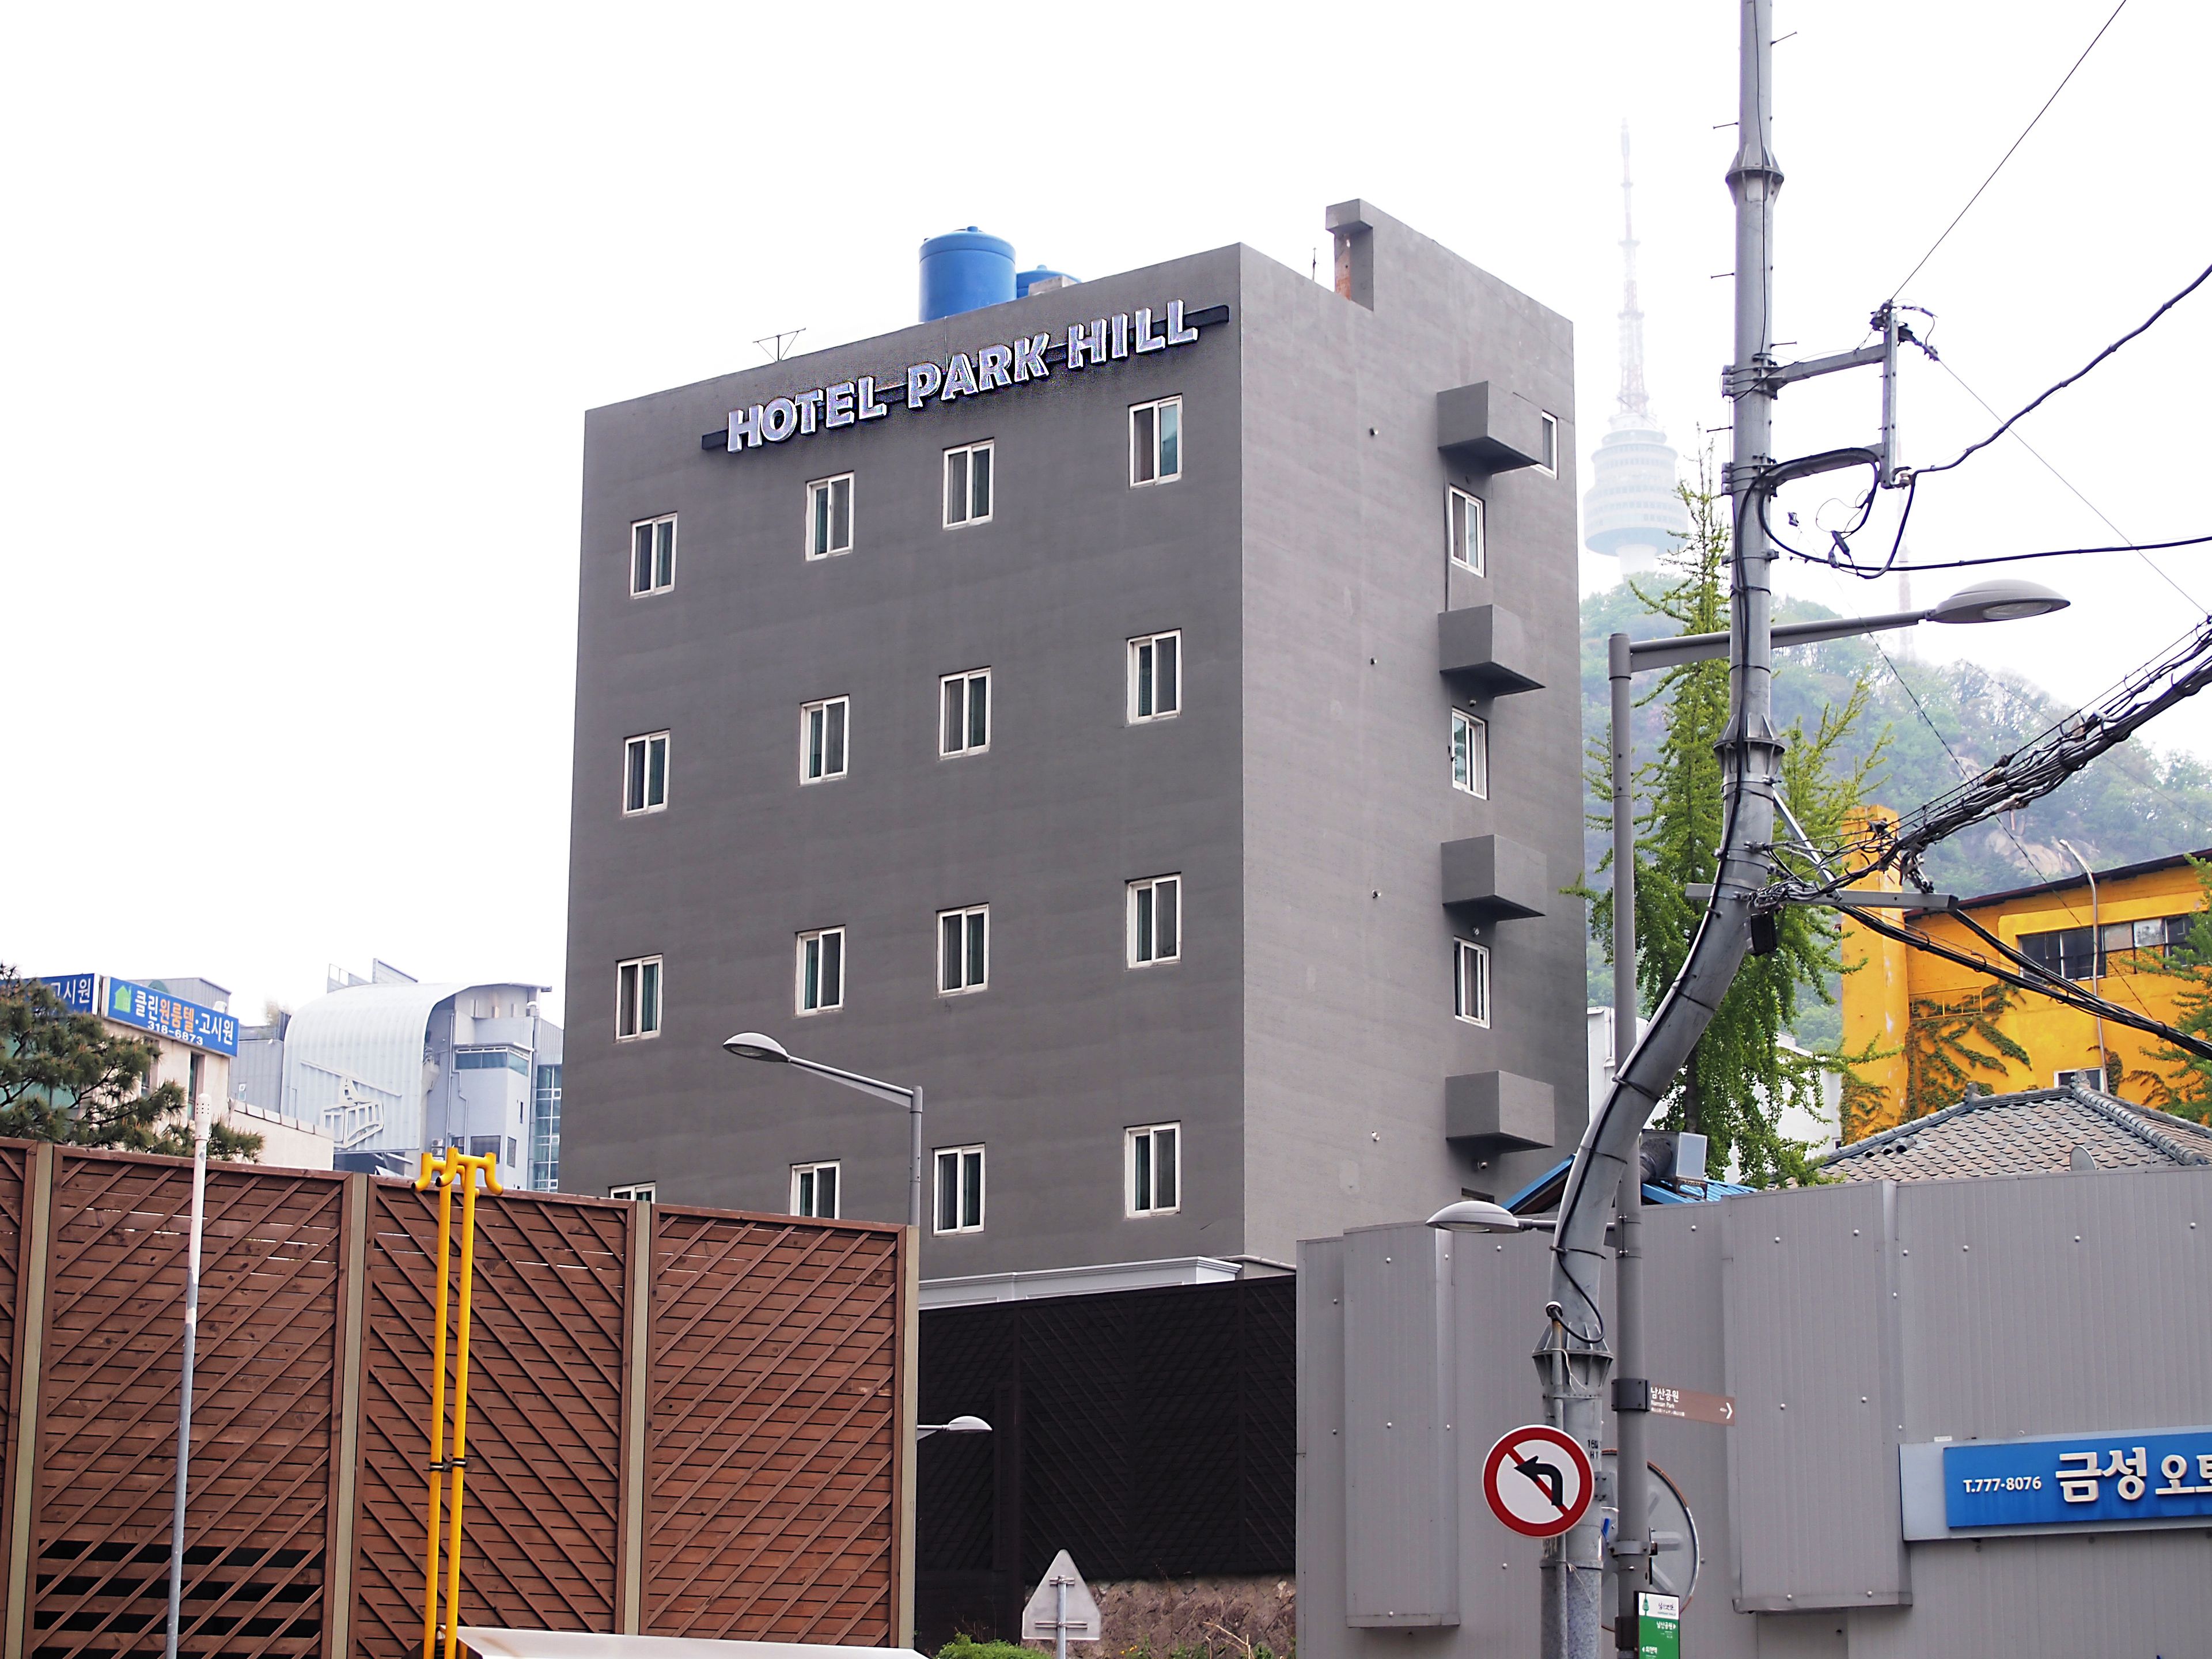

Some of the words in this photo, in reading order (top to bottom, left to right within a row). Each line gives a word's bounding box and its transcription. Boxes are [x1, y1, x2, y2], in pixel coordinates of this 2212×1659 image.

[727, 376, 887, 453] HOTEL
[907, 332, 1050, 408] PARK
[1068, 299, 1198, 369] HILL
[147, 1021, 203, 1046] 318-6873
[1650, 1387, 1679, 1403] 남산공원
[1963, 1476, 2042, 1493] T.777-8076
[2055, 1446, 2147, 1503] 금성
